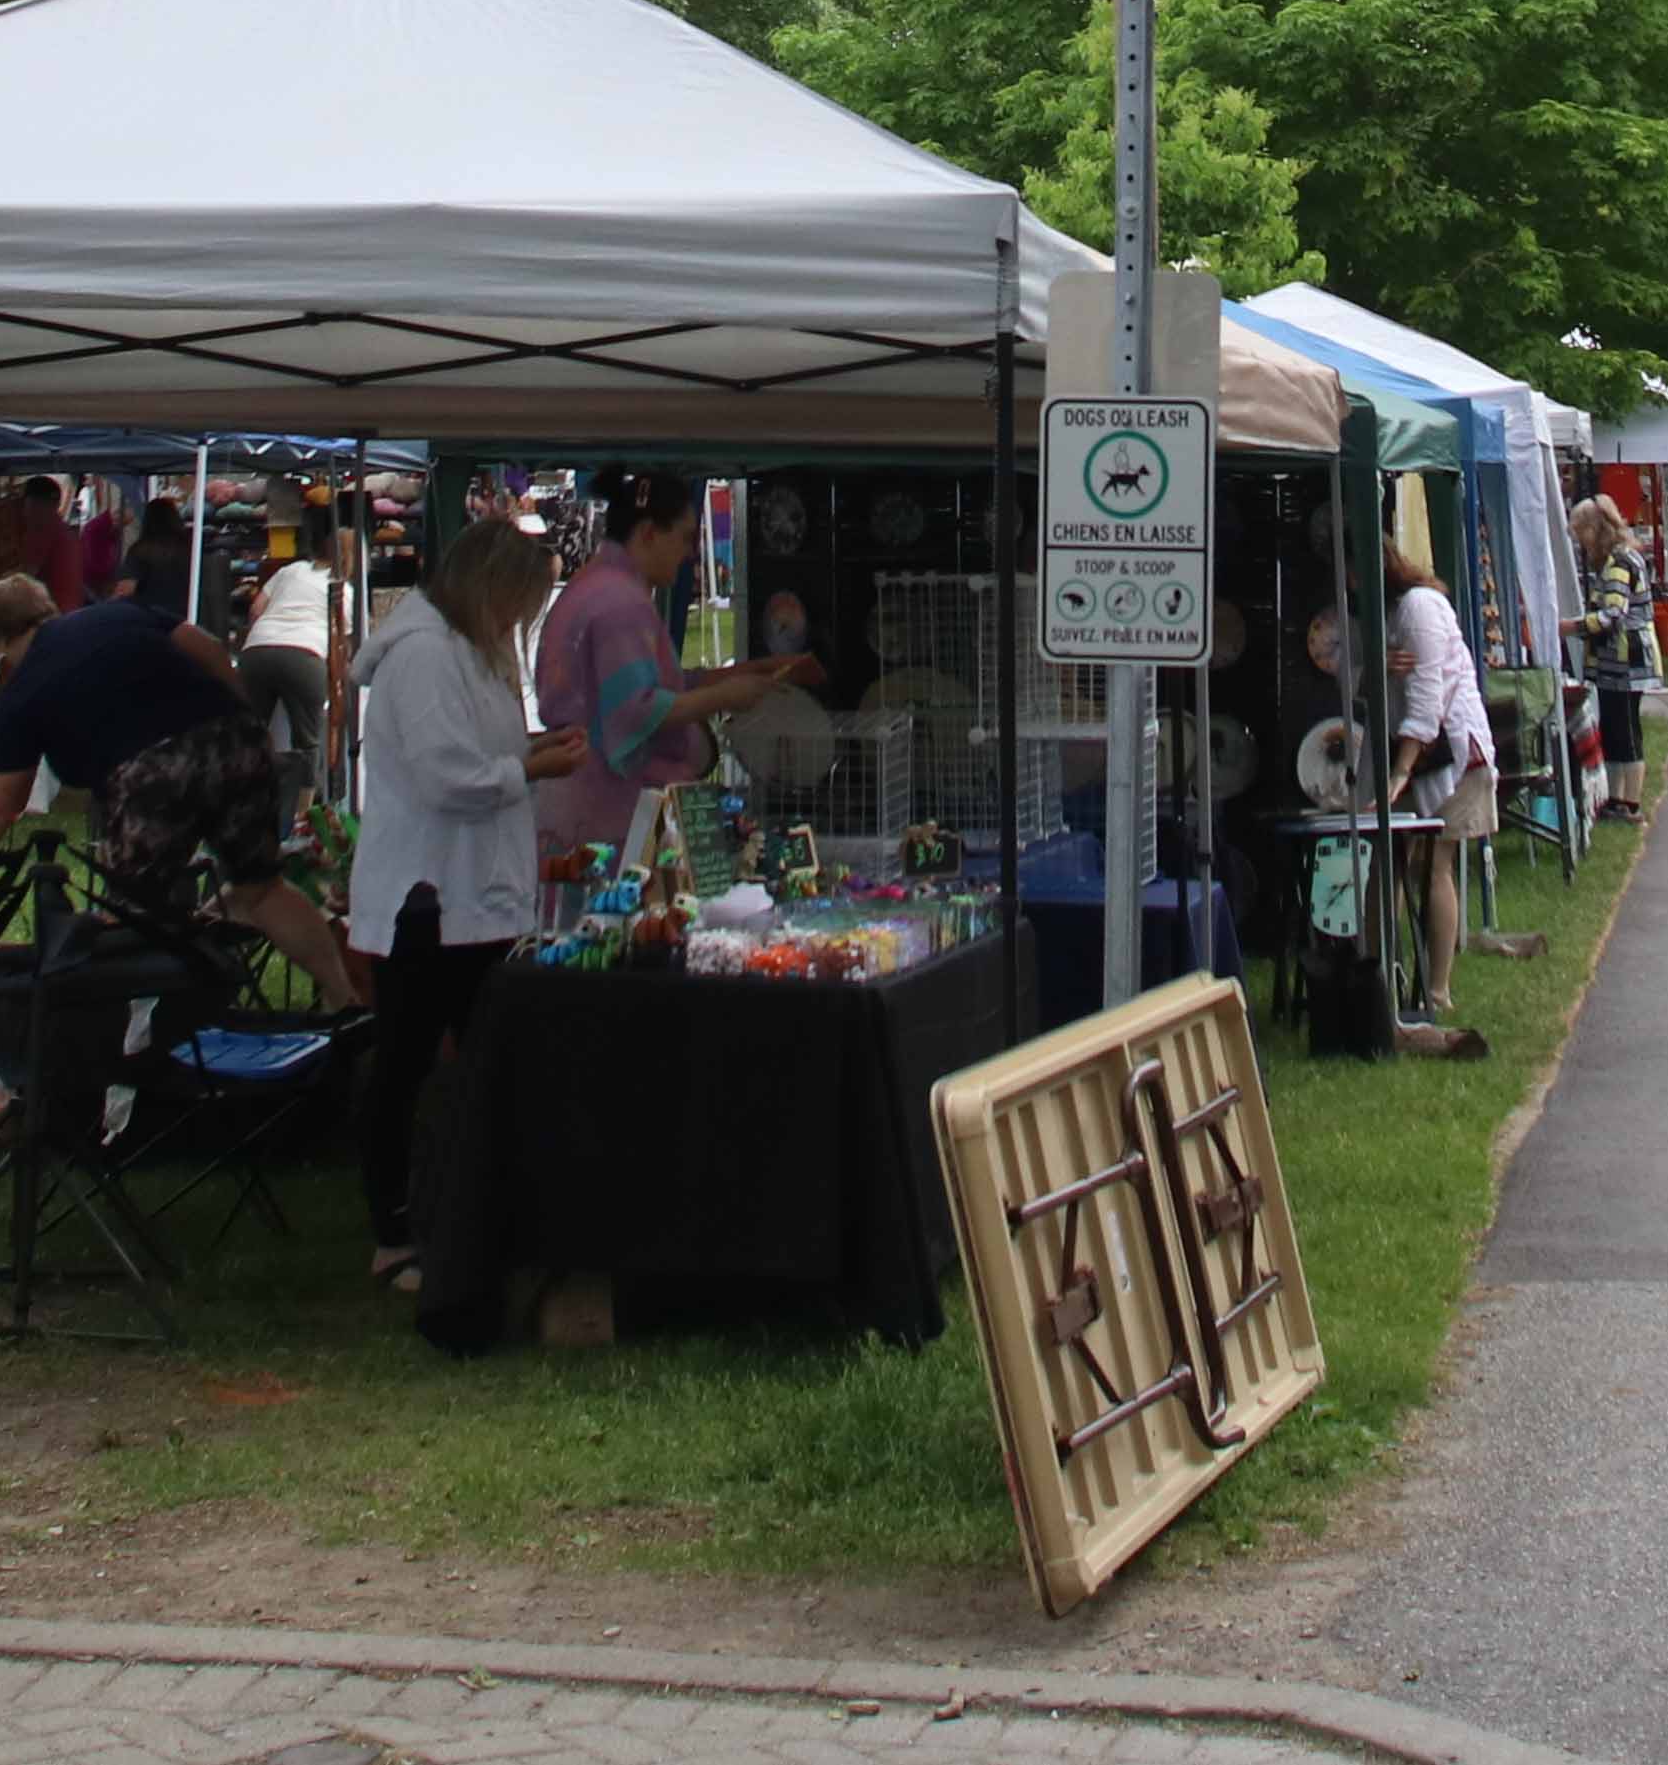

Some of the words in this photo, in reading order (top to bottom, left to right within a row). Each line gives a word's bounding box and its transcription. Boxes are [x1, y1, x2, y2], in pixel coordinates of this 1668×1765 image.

[1064, 409, 1106, 427] DOGS
[1137, 410, 1190, 428] LEASH
[1052, 524, 1110, 543] CHIENS
[1114, 525, 1135, 543] EN
[1139, 526, 1197, 544] LAISSE
[1074, 560, 1115, 575] STOOP
[1119, 561, 1130, 575] &
[1134, 561, 1177, 576] SCOOP
[1146, 630, 1165, 645] EN
[1166, 630, 1200, 645] MAIN
